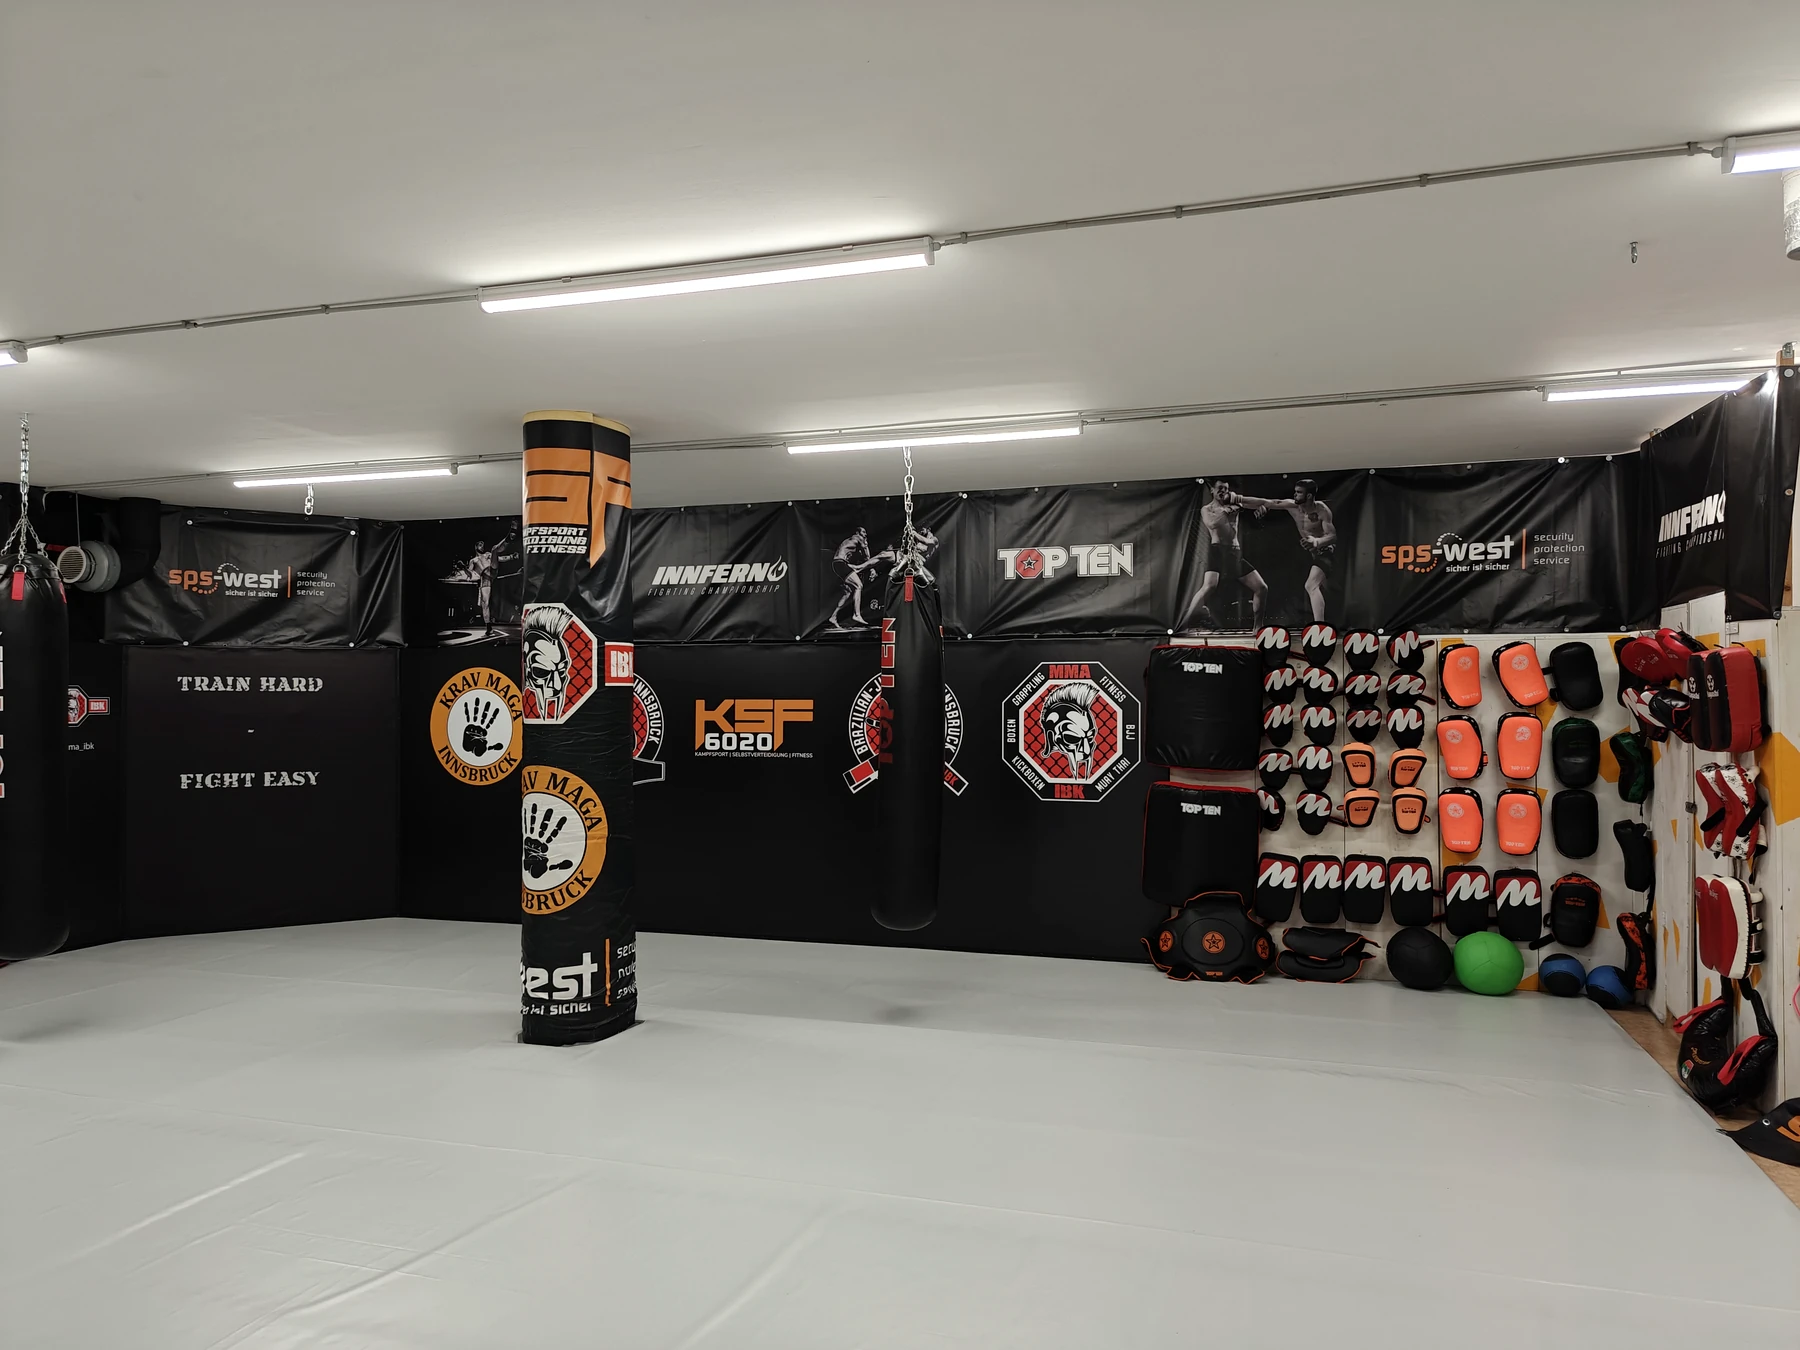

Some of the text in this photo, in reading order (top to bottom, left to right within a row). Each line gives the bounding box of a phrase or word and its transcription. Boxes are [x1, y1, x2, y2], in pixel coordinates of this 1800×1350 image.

[1534, 532, 1574, 543] security
[527, 545, 588, 554] FITNESS
[1381, 534, 1515, 570] sps-west
[1533, 543, 1585, 555] protection
[997, 542, 1134, 580] TOP TEN
[1445, 562, 1510, 573] sicher ist sicher
[1533, 556, 1570, 565] service
[297, 571, 328, 580] security
[651, 555, 788, 585] INNFERNO
[168, 569, 282, 591] sps-west
[297, 580, 336, 588] protection
[225, 589, 279, 598] sicher ist sicher
[297, 589, 325, 597] service
[647, 584, 780, 597] FIGHTING CHAMPIONSHIP
[1048, 664, 1091, 678] MMA
[1181, 661, 1223, 674] TOP TEN
[177, 676, 324, 692] TRAIN HARD
[1012, 672, 1046, 706] GRAPPLING
[1099, 675, 1127, 703] FITNESS
[439, 672, 522, 722] KRAV MAGA
[90, 701, 106, 711] IBK
[633, 679, 661, 745] INNSBRUCK
[695, 699, 814, 752] KSF
[945, 689, 961, 753] NSBRUCK
[1006, 719, 1016, 743] BOXEN
[1126, 724, 1136, 740] BJJ
[704, 732, 773, 751] 6020
[438, 745, 518, 782] INNSBRUCK
[180, 771, 320, 789] FIGHT EASY
[1012, 755, 1046, 791] KICKBOXEN
[1094, 757, 1131, 793] MUAY THAI
[1054, 784, 1086, 799] IBK
[545, 772, 603, 832] MAGA
[1180, 802, 1222, 816] TOP TEN
